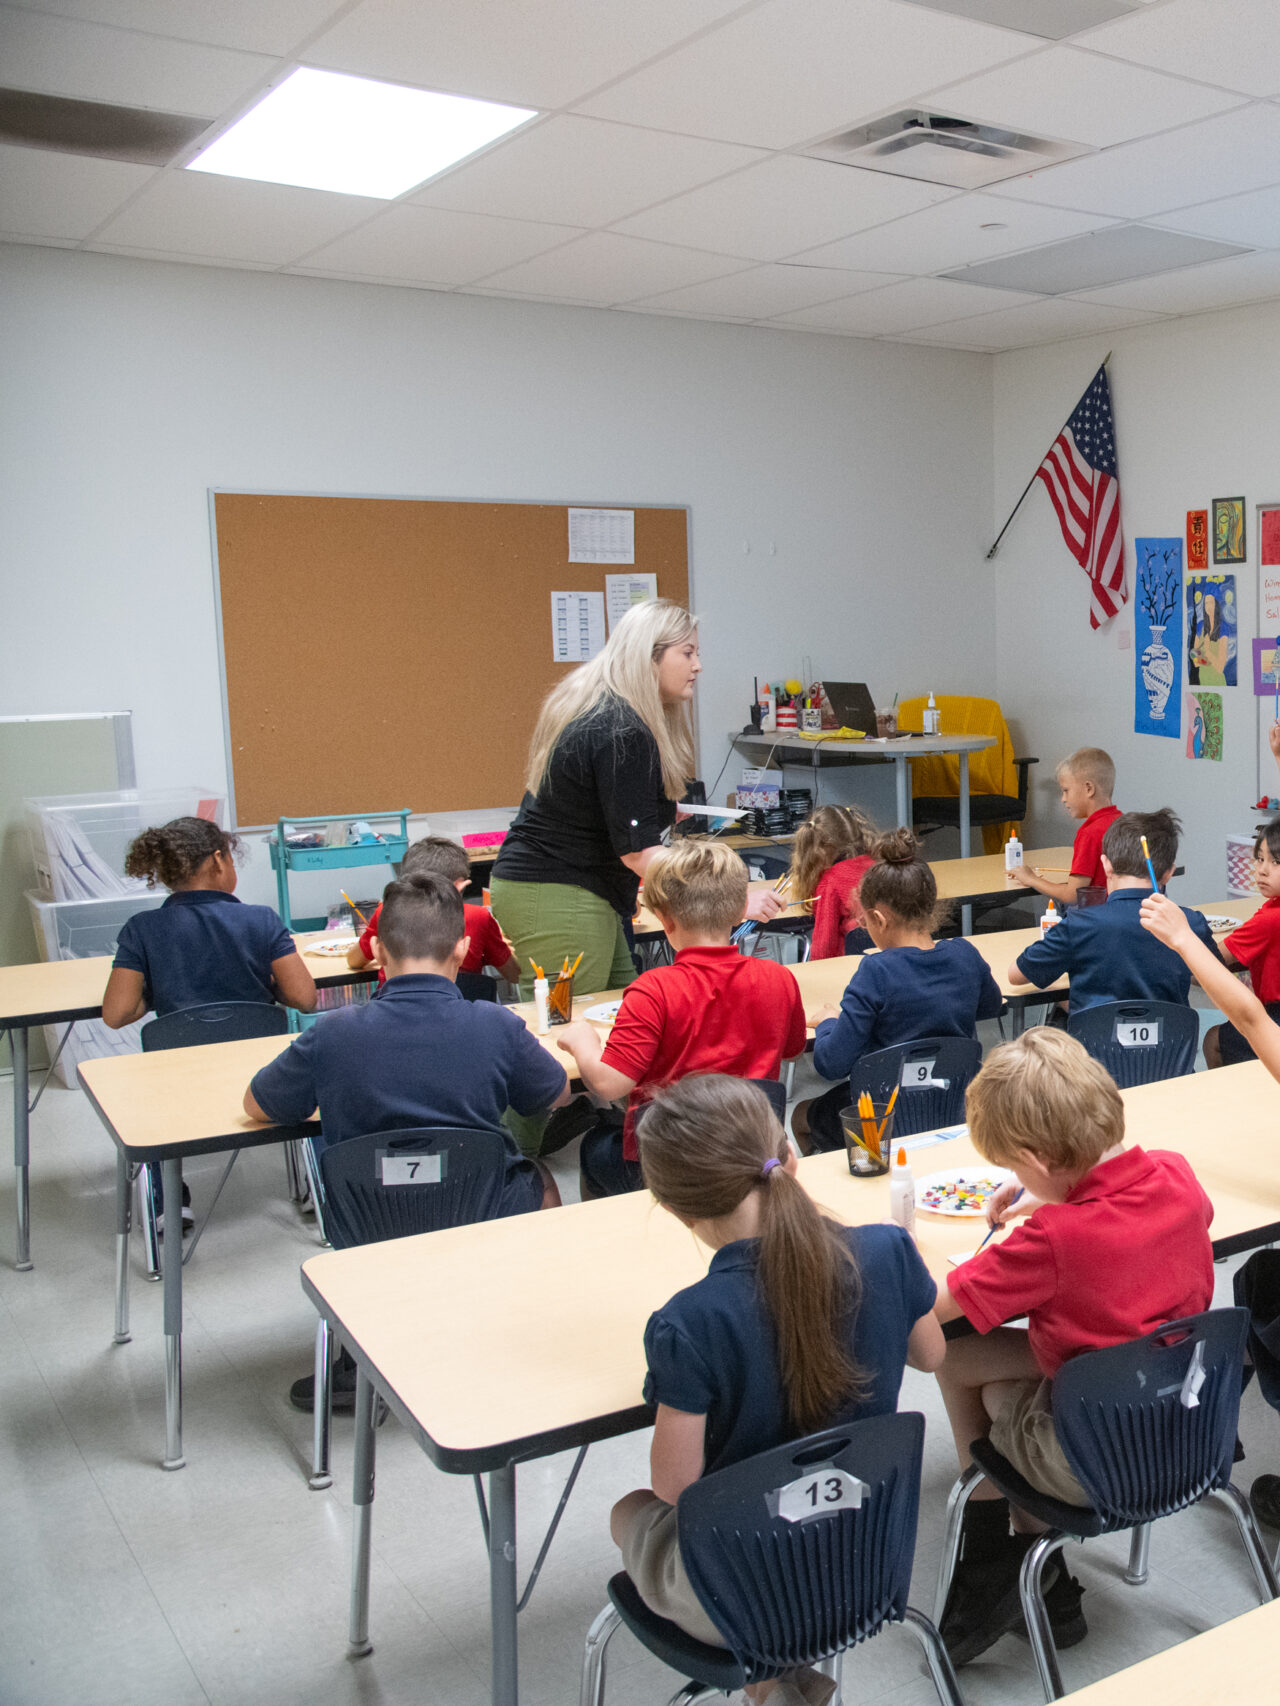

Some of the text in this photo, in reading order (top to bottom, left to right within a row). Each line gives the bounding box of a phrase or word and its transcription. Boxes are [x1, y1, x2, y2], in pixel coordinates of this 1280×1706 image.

[757, 871, 763, 879] 4
[1130, 1028, 1150, 1042] 10
[916, 1066, 928, 1082] 9
[406, 1162, 420, 1178] 7
[804, 1477, 844, 1507] 13
